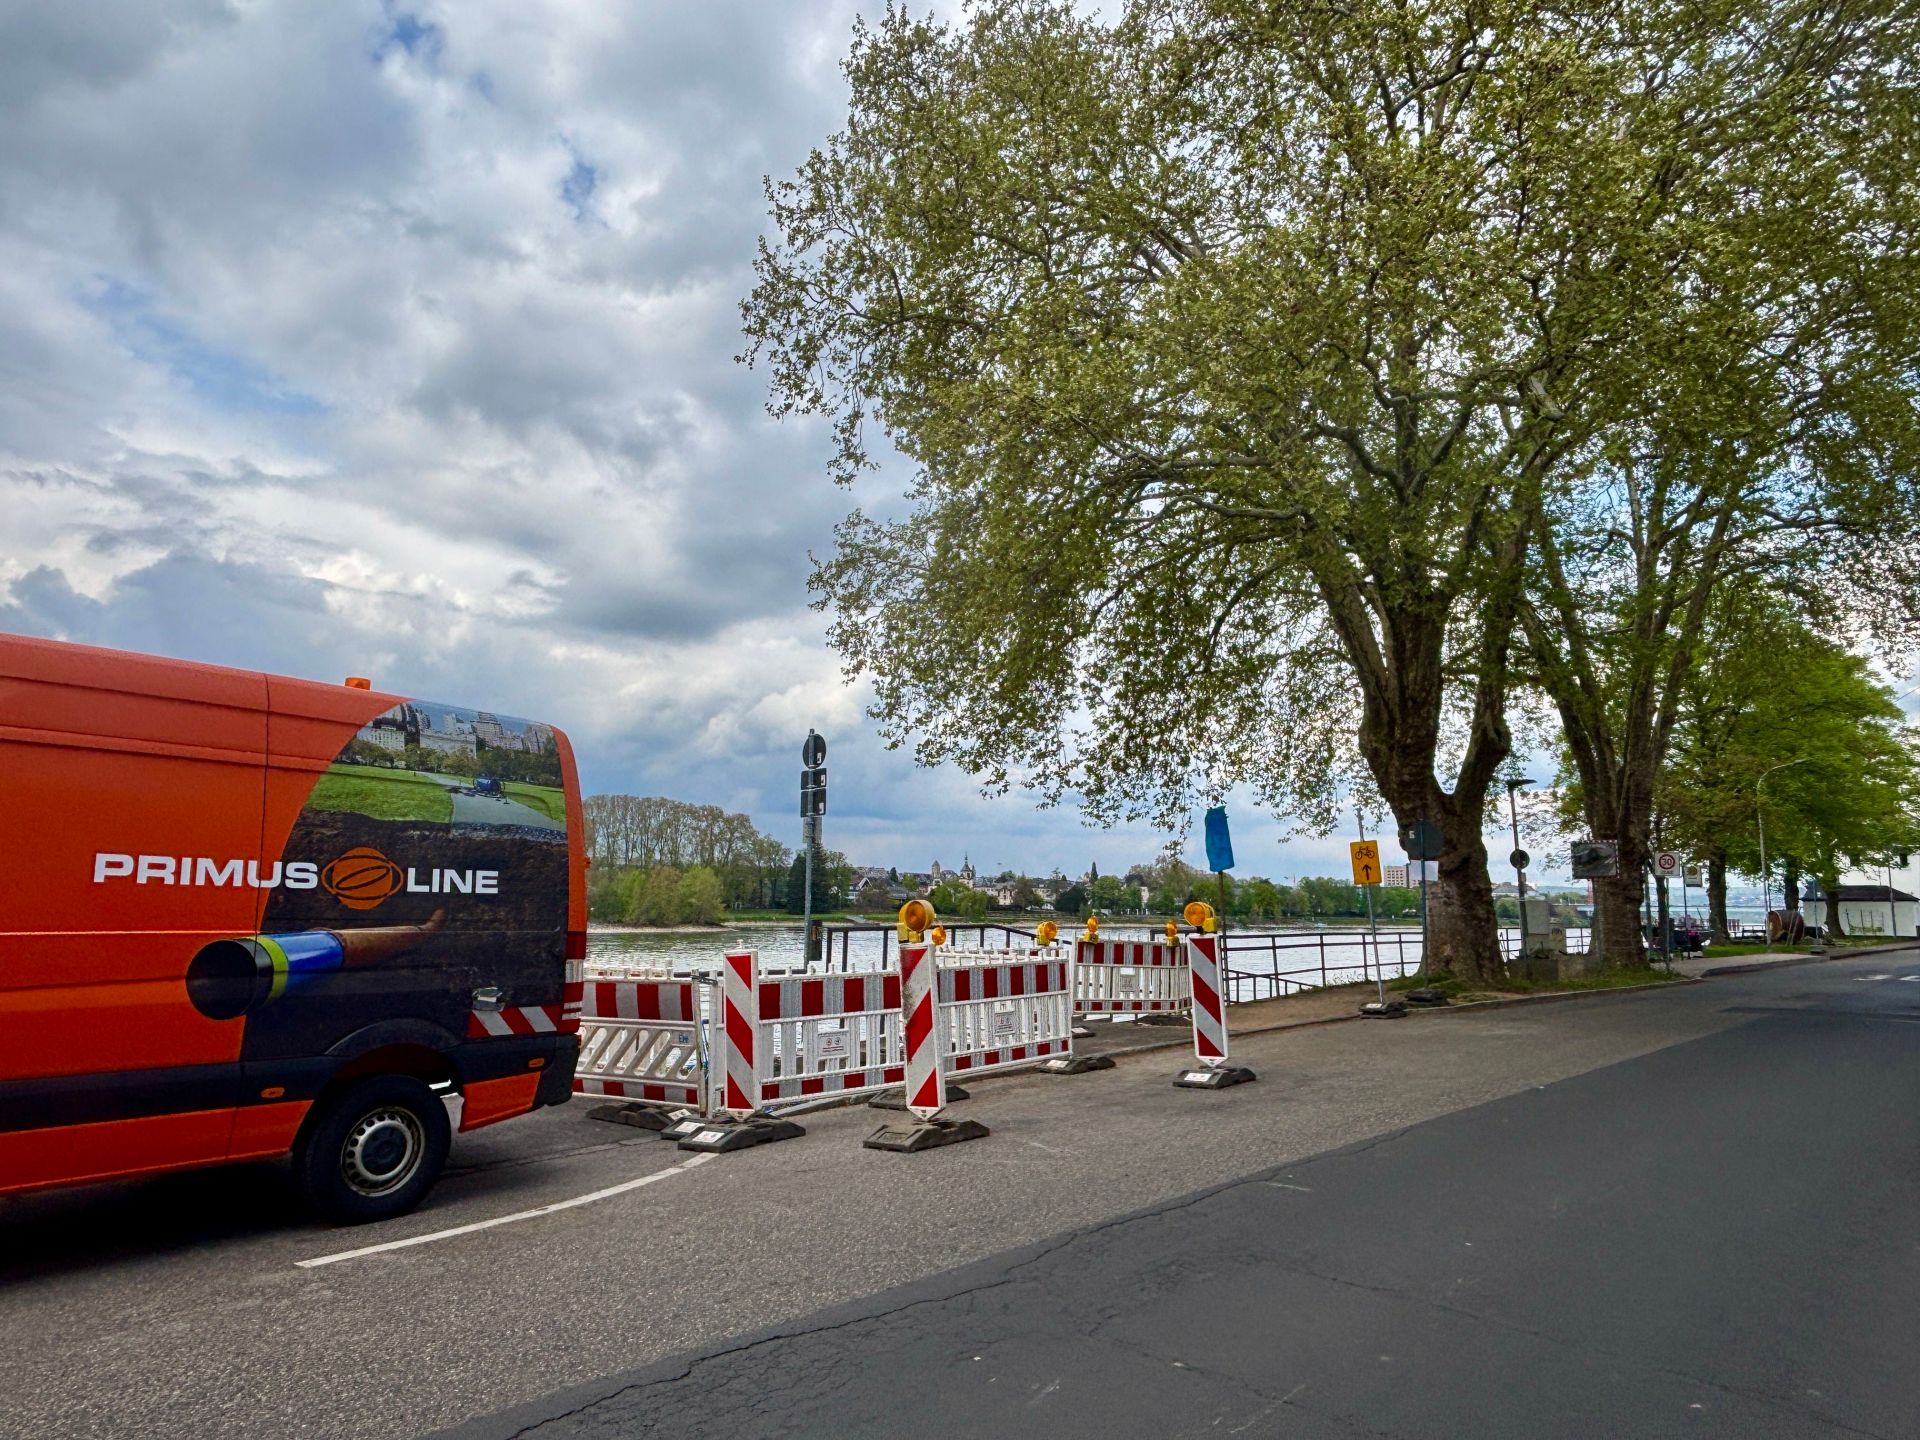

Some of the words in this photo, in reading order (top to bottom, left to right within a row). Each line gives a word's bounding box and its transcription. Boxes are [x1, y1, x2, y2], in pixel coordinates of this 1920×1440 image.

[93, 853, 318, 889] PRIMUS
[406, 867, 499, 895] LINE
[1662, 858, 1672, 866] 30
